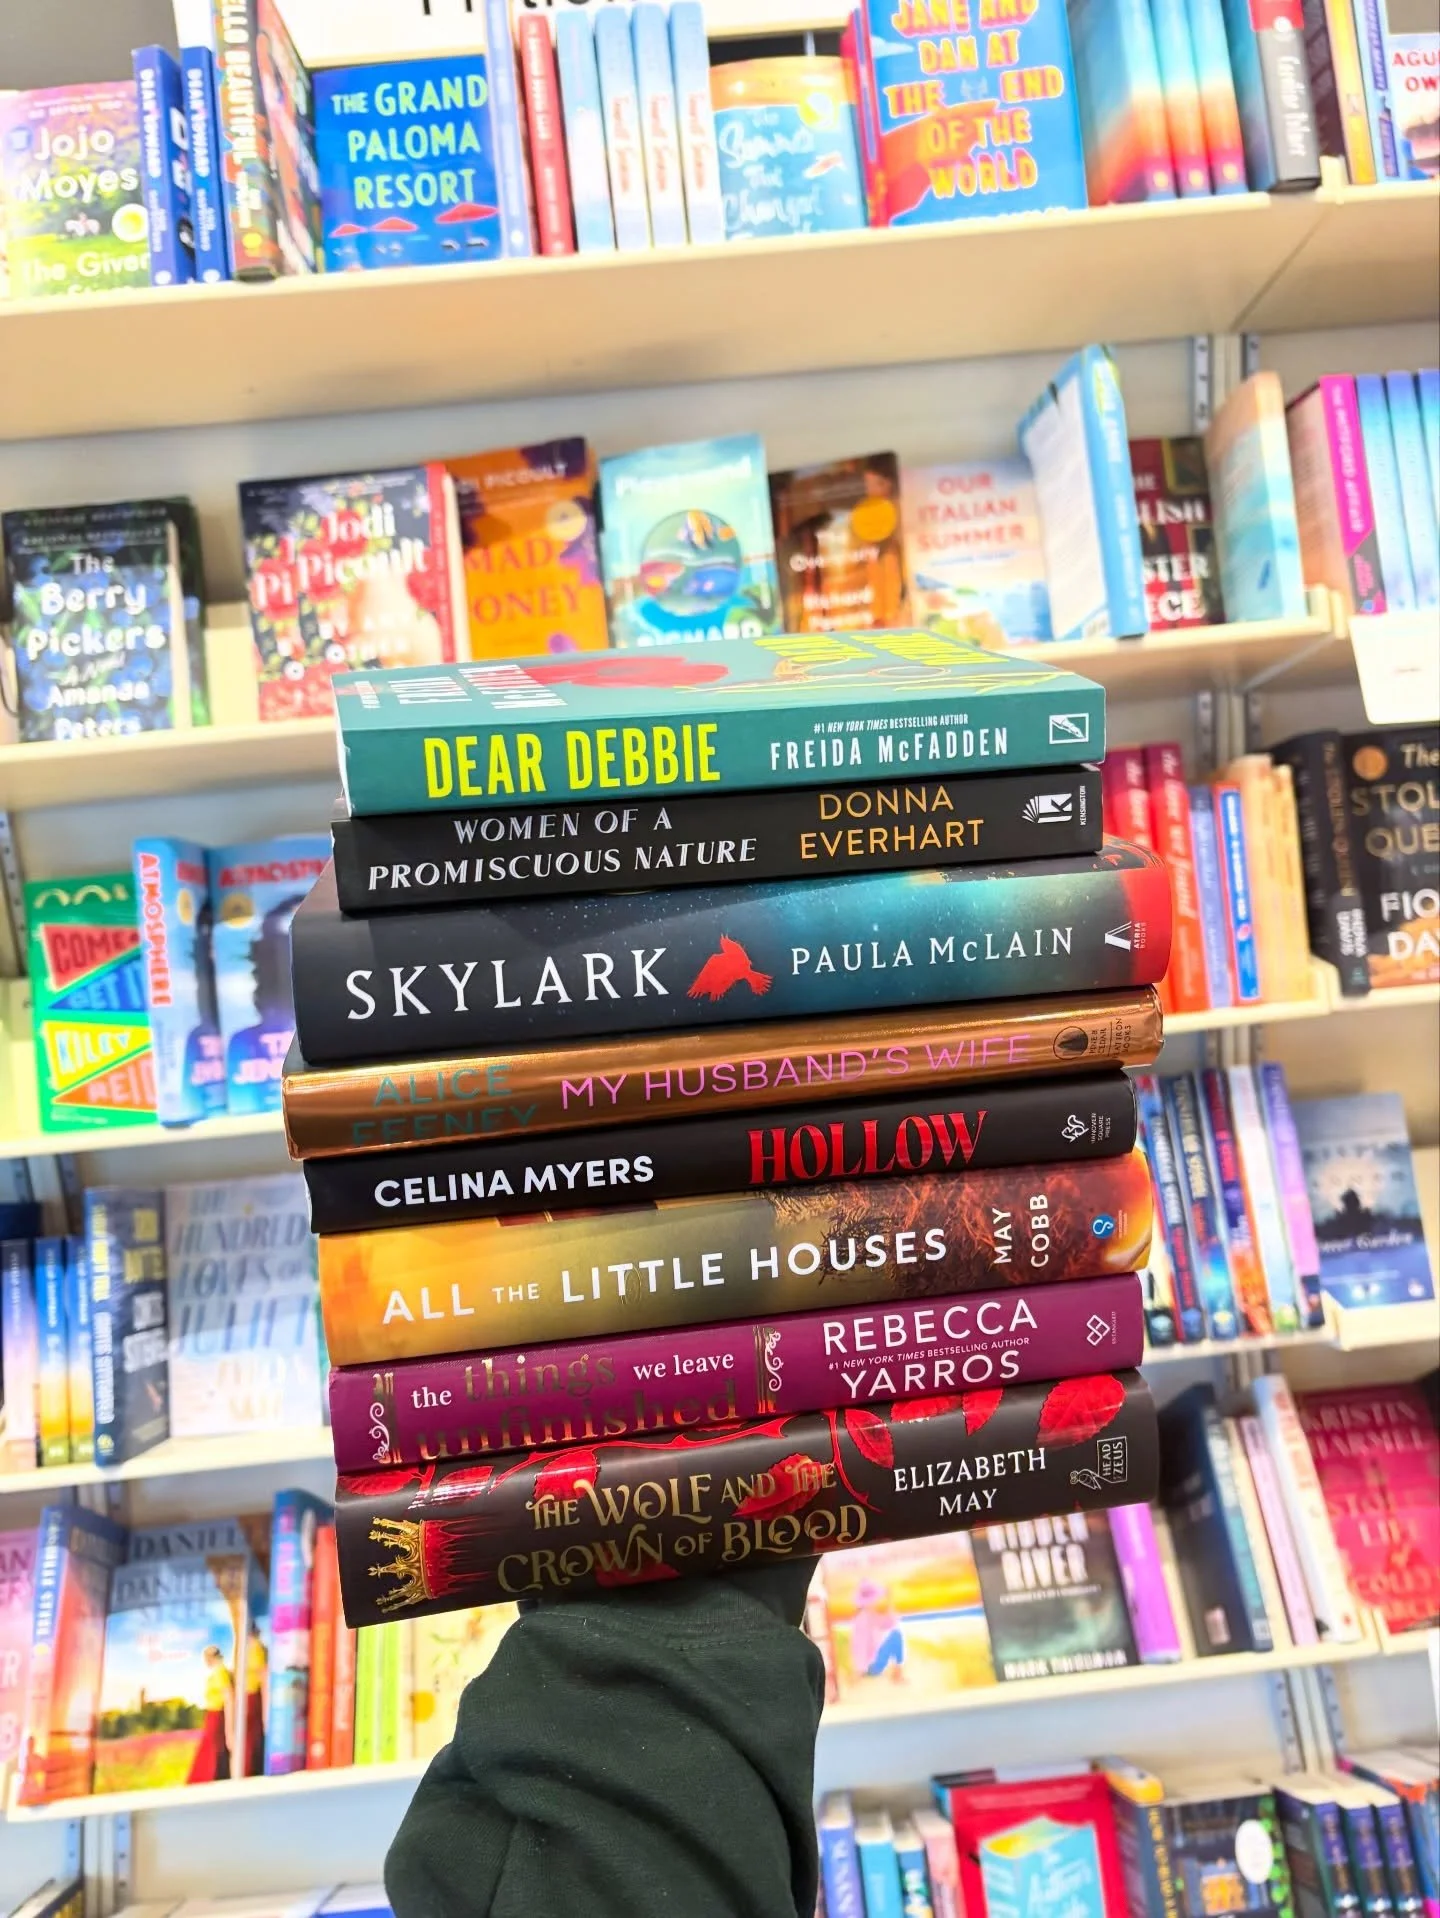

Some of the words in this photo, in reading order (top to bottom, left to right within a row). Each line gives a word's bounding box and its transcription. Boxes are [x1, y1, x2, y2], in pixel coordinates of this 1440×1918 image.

[892, 0, 969, 37] JANE
[979, 0, 1039, 29] AND
[919, 35, 978, 75] DAN
[987, 29, 1021, 68] AT
[1393, 52, 1440, 66] AGU
[331, 93, 368, 115] THE
[374, 73, 488, 114] GRAND
[884, 80, 945, 118] THE
[1001, 65, 1064, 103] END
[1405, 76, 1440, 91] OW
[224, 50, 257, 164] BEAUTIFUL
[34, 125, 114, 160] Jojo
[348, 122, 481, 162] PALOMA
[925, 119, 966, 153] OF
[973, 108, 1032, 148] THE
[18, 168, 138, 203] Moyes
[354, 168, 476, 211] RESORT
[928, 149, 1038, 199] WORLD
[938, 472, 993, 495] OUR
[326, 502, 396, 543] Jodi
[917, 497, 1017, 524] ITALIAN
[1138, 499, 1206, 526] LISH
[917, 523, 1024, 552] SUMMER
[70, 552, 115, 575] The
[298, 537, 428, 589] Picoult
[1143, 553, 1211, 583] STER
[40, 582, 147, 616] Berry
[474, 583, 579, 624] ONEY
[1145, 589, 1207, 624] ECE
[47, 681, 150, 708] Amanda
[814, 723, 825, 734] #1
[828, 722, 843, 733] NEW
[846, 721, 864, 732] YORK
[866, 719, 888, 731] TIMES
[890, 716, 938, 729] BESTSELLING
[939, 714, 969, 726] AUTHOR
[424, 733, 546, 798] DEAR
[565, 723, 721, 790] DEBBIE
[771, 737, 862, 771] FREIDA
[878, 727, 1008, 762] McFADDEN
[1402, 744, 1440, 769] The
[818, 785, 954, 821] DONNA
[1351, 781, 1440, 817] STOL
[454, 812, 580, 845] WOMEN
[595, 808, 639, 834] OF
[653, 806, 673, 831] A
[800, 818, 984, 860] EVERHART
[1365, 823, 1440, 861] QUE
[368, 847, 621, 891] PROMISCUOUS
[634, 836, 757, 871] NATURE
[1380, 888, 1440, 921] FIO
[138, 851, 173, 1007] ATMOSPHERE
[51, 929, 126, 976] COME
[791, 937, 914, 976] PAULA
[929, 926, 1073, 965] McLAIN
[346, 947, 670, 1020] SKYLARK
[53, 1028, 131, 1076] KILEY
[561, 1073, 630, 1109] MY
[644, 1045, 910, 1101] HUSBAND'S
[924, 1034, 1031, 1072] WIFE
[373, 1063, 514, 1108] ALICE
[352, 1104, 540, 1147] FEENEY
[747, 1110, 989, 1184] HOLLOW
[374, 1169, 514, 1207] CELINA
[524, 1155, 654, 1195] MYERS
[994, 1207, 1012, 1264] MAY
[1030, 1194, 1049, 1268] COBB
[383, 1283, 475, 1325] ALL
[491, 1282, 540, 1306] THE
[560, 1252, 726, 1304] LITTLE
[750, 1228, 947, 1281] HOUSES
[823, 1299, 1038, 1356] REBECCA
[828, 1361, 839, 1370] #1
[843, 1357, 866, 1369] NEW
[868, 1353, 895, 1366] YORK
[897, 1350, 925, 1362] TIMES
[927, 1343, 988, 1359] BESTSELLING
[990, 1337, 1030, 1350] AUTHOR
[841, 1349, 1020, 1399] YARROS
[412, 1386, 452, 1409] the
[463, 1353, 616, 1401] things
[632, 1362, 670, 1381] we
[674, 1352, 735, 1377] leave
[417, 1379, 737, 1461] unfinished
[894, 1446, 1047, 1493] ELIZABETH
[1102, 1443, 1111, 1476] HEAD
[1113, 1440, 1123, 1476] ZEUS
[525, 1497, 581, 1530] THE
[573, 1473, 712, 1526] WOLF
[720, 1472, 776, 1503] AND
[788, 1459, 838, 1491] THE
[939, 1489, 997, 1517] MAY
[132, 1525, 236, 1559] DANIEL
[498, 1524, 664, 1593] CROWN
[674, 1530, 713, 1559] OF
[721, 1502, 868, 1563] BLOOD
